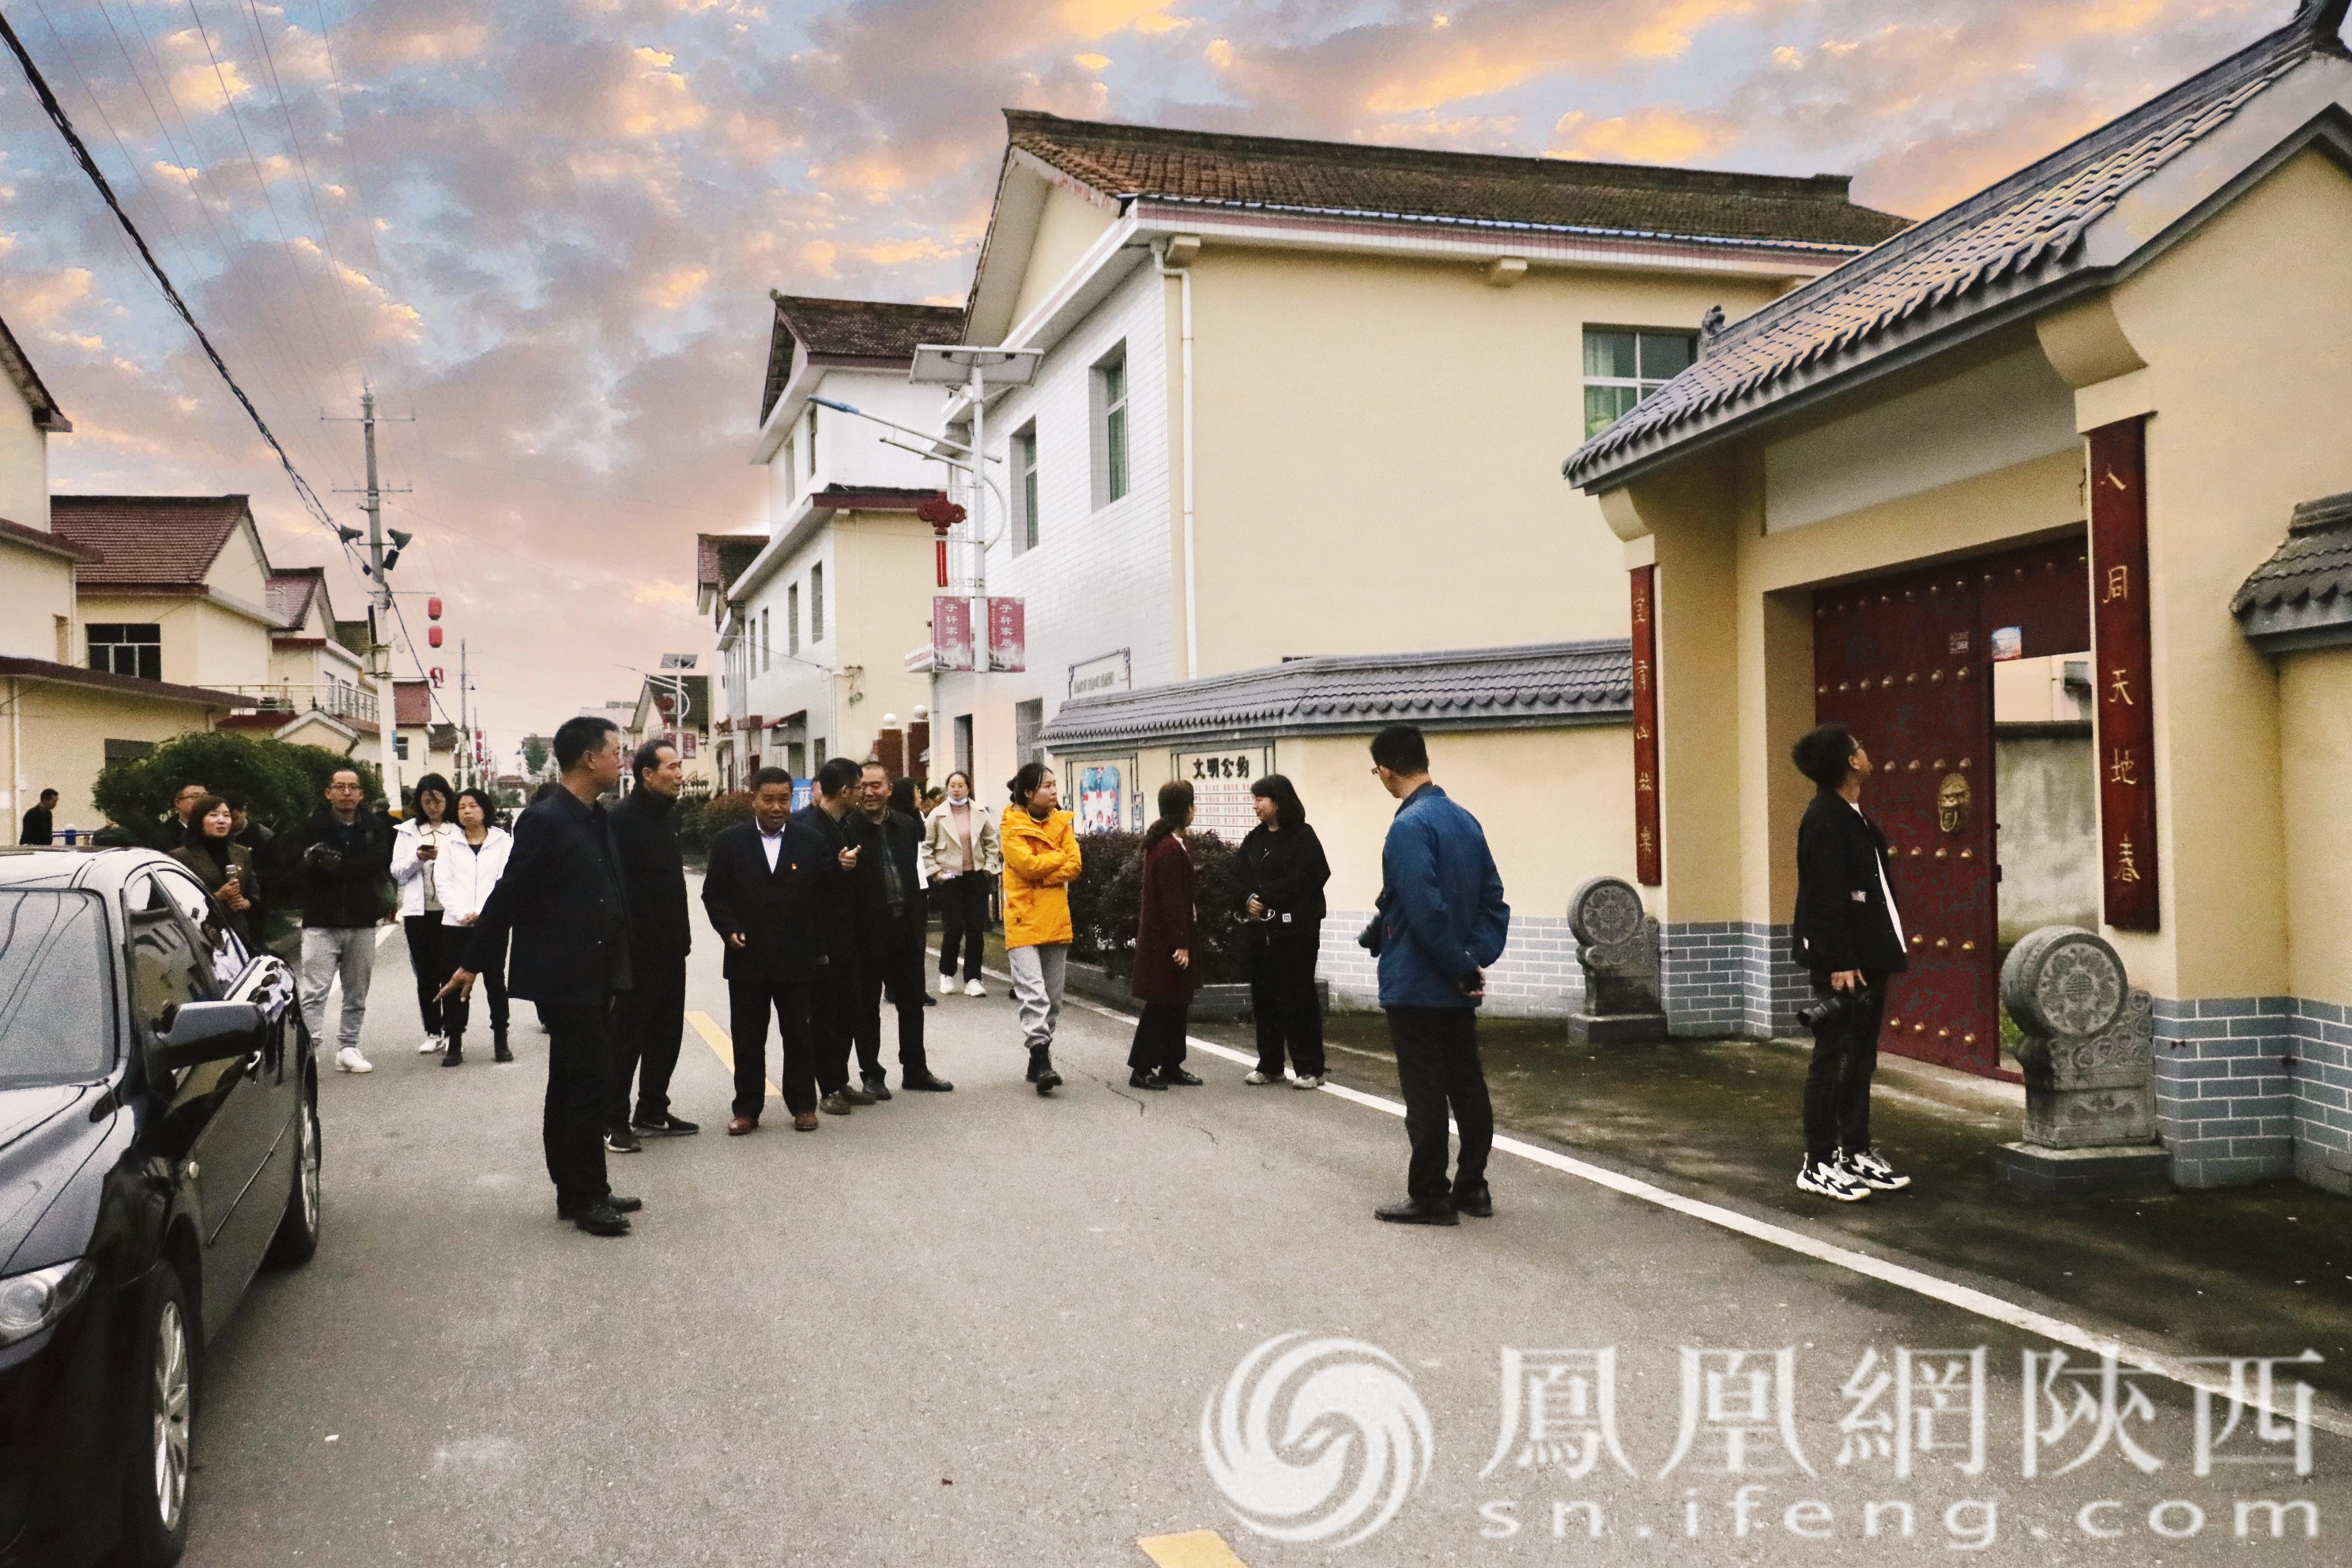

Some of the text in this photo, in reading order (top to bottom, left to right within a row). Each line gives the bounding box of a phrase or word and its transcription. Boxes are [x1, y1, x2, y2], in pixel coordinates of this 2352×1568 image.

[944, 603, 959, 647] 子轩家居
[999, 604, 1012, 647] 子轩家居
[2100, 463, 2140, 882] 人同天地春
[1193, 755, 1250, 779] 文明公约
